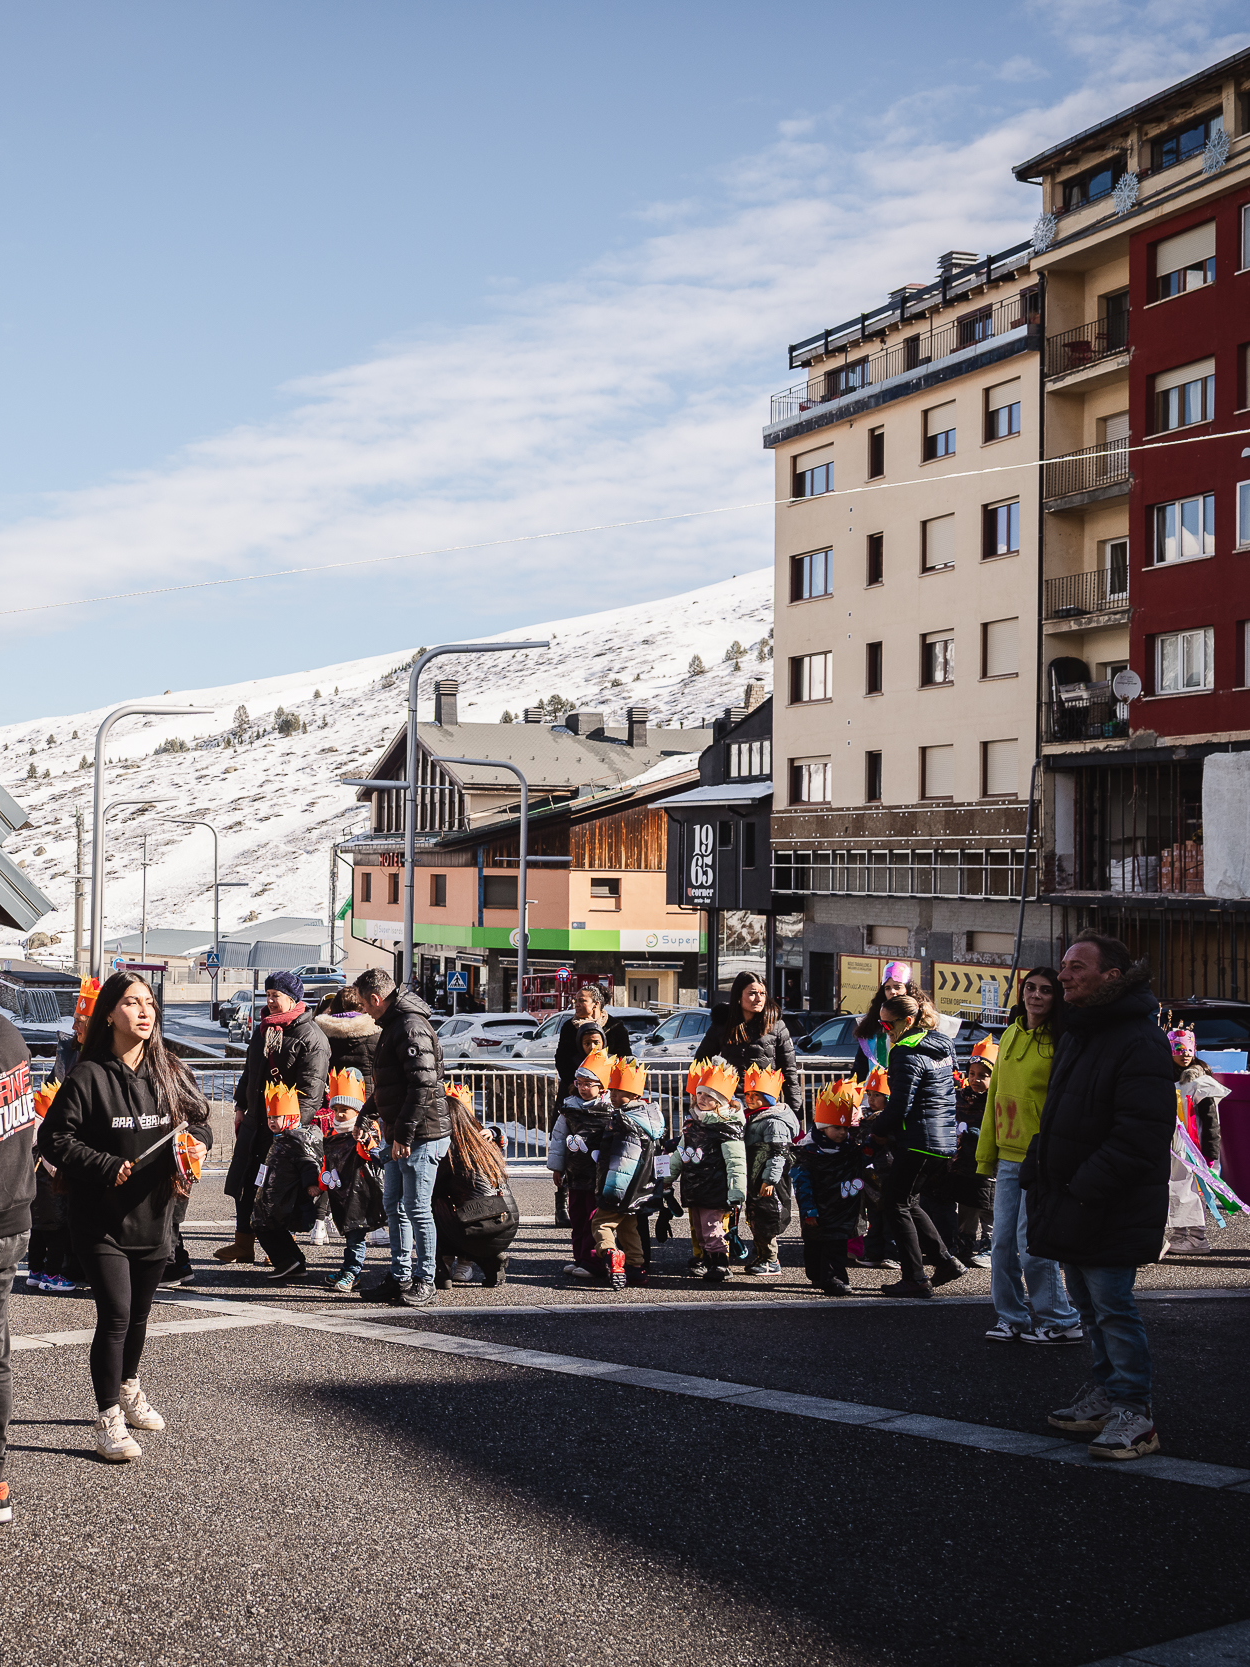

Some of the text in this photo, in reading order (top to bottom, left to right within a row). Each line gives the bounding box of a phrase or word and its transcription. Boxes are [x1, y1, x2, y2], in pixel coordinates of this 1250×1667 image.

[693, 824, 714, 856] 19
[378, 853, 402, 867] HOTEL
[691, 853, 714, 886] 65
[662, 935, 698, 947] Super
